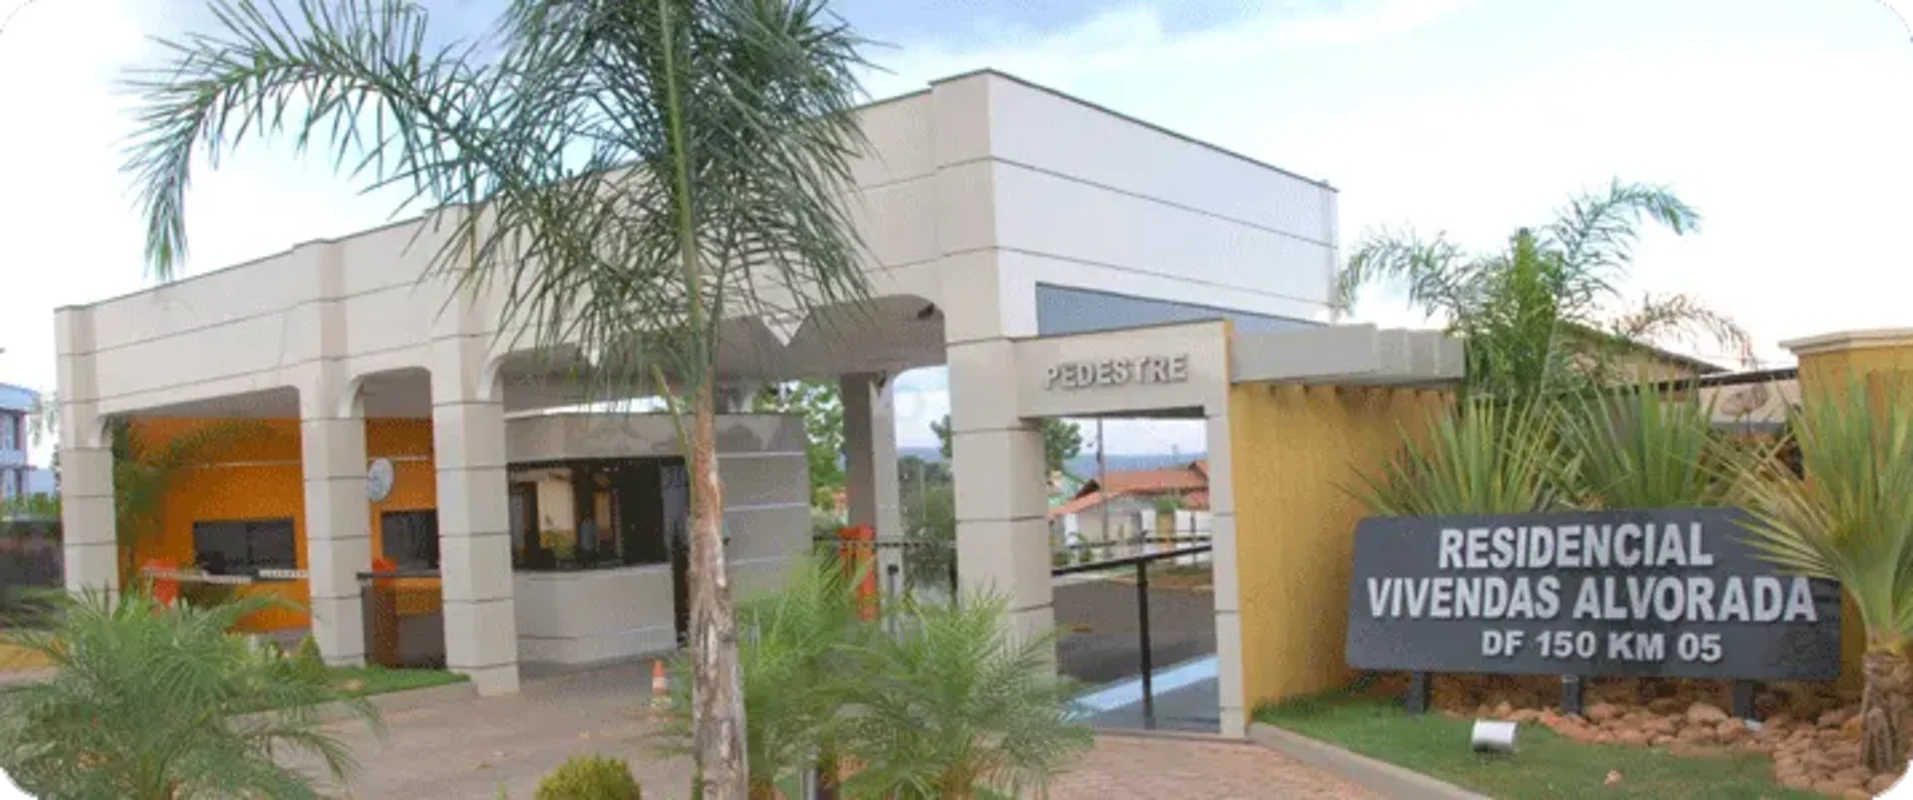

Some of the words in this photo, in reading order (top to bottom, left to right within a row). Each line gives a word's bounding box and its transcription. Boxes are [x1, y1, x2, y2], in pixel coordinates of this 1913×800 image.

[1044, 355, 1188, 390] PEDESTRE
[1438, 523, 1714, 569] RESIDENCIAL
[1367, 576, 1560, 619] VIVENDAS
[1572, 576, 1818, 622] ALVORADA
[1481, 630, 1524, 657] DF
[1536, 631, 1596, 658] 150
[1608, 632, 1664, 661] KM
[1677, 633, 1722, 662] 05
